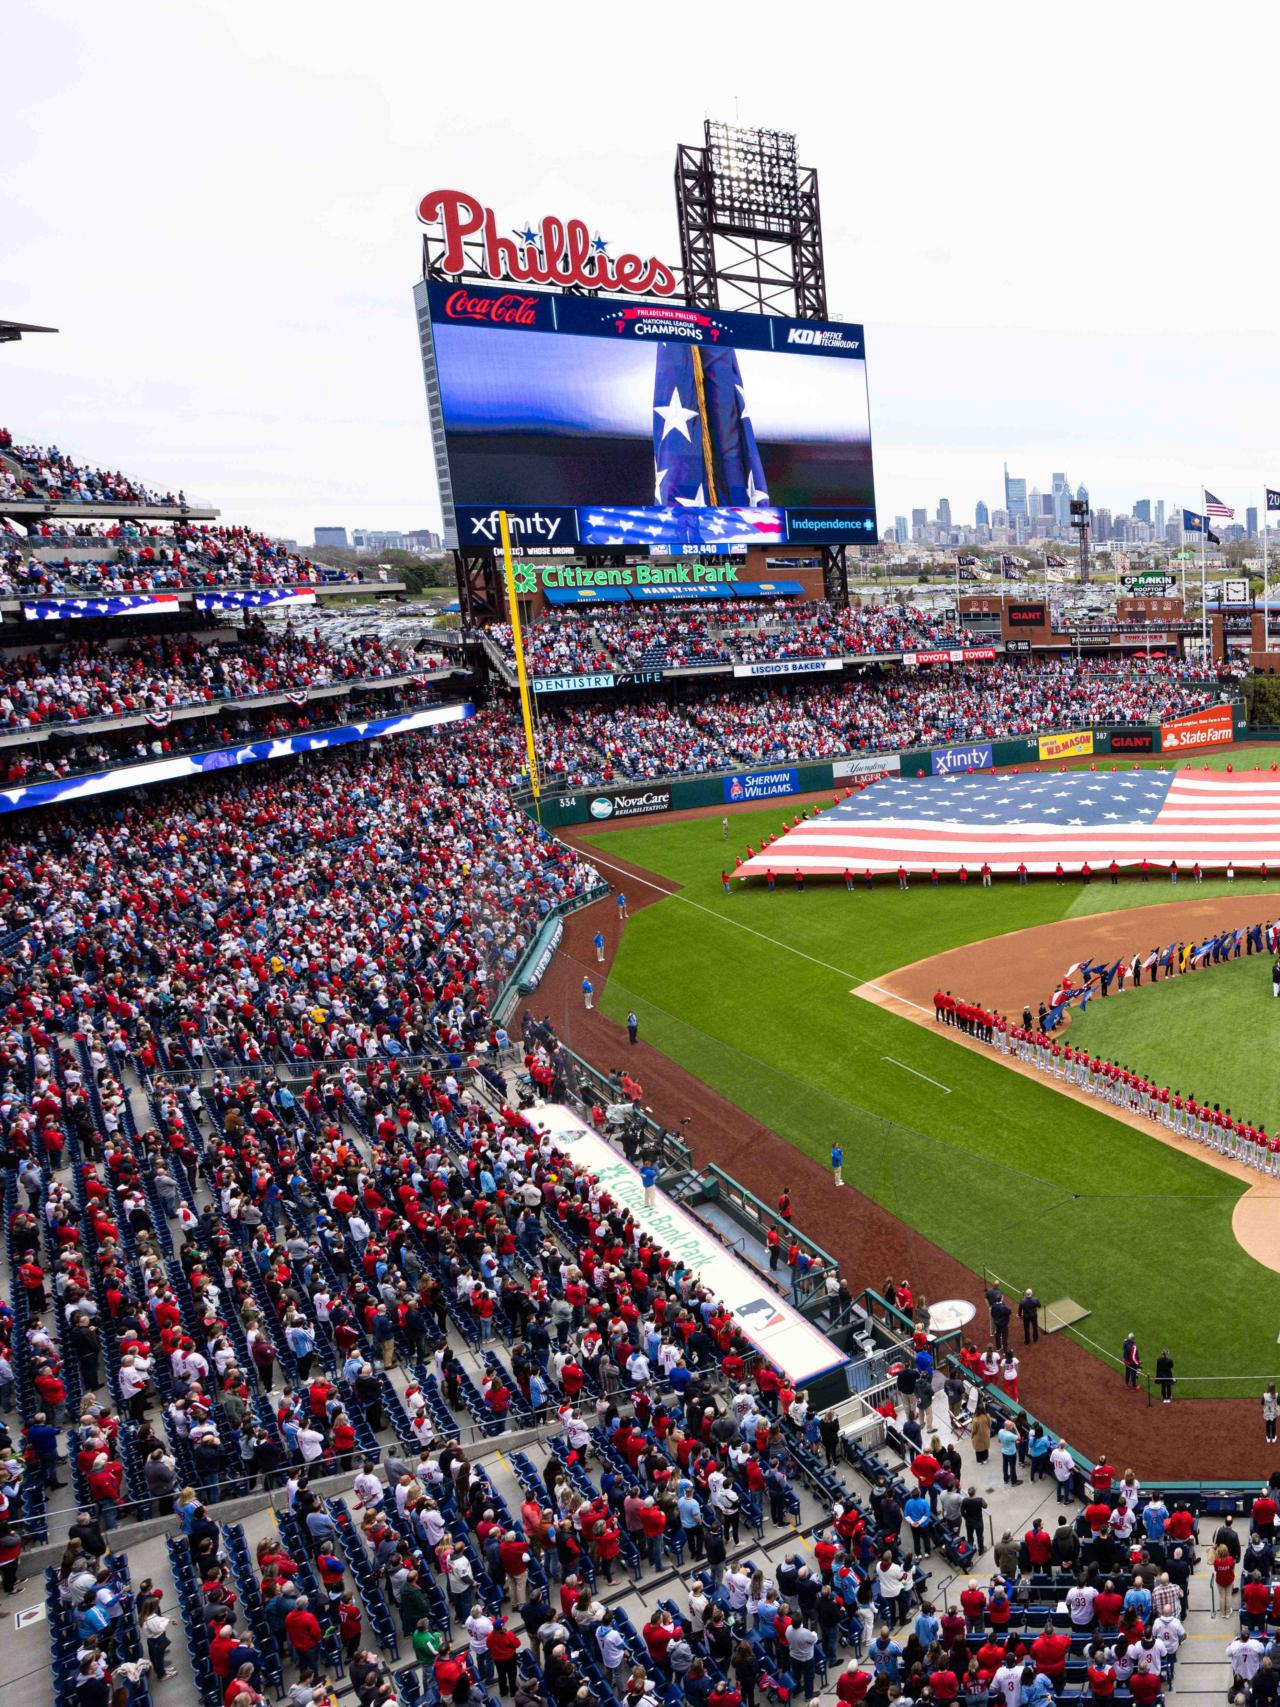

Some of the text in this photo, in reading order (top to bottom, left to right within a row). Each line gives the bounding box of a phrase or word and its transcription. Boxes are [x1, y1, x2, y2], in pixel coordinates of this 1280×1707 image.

[418, 190, 677, 296] Phillies
[445, 289, 540, 325] Coca-Cola
[637, 309, 698, 321] PHILADELPHIA PHILLIES
[642, 318, 695, 329] NATIONAL LEAGUE
[634, 323, 703, 340] CHAMPIONS
[822, 331, 843, 340] OFFICE
[821, 338, 860, 349] TECHNOLOGY
[470, 510, 561, 540] xfnity
[792, 519, 862, 532] Independence
[526, 547, 575, 555] WHOSE BROAD
[541, 562, 738, 587] Citizens Bank Park
[1124, 576, 1138, 584] CP
[642, 586, 682, 594] HARRY
[1012, 612, 1042, 620] GIANT
[918, 652, 949, 662] TOYOTA
[964, 650, 994, 659] TOYOTA
[751, 661, 828, 674] LISCIO'S BAKERY
[534, 671, 661, 691] DENTISTRY for LIFE
[1112, 737, 1152, 747] GIANT
[1180, 728, 1232, 745] State Farm
[936, 749, 989, 772] xfinity
[846, 761, 888, 774] Yuengling
[745, 772, 790, 787] SHERWIN
[560, 797, 576, 808] 334
[613, 792, 670, 809] NovaCare
[615, 803, 668, 816] REHABILITATION
[611, 1179, 717, 1269] Citizens Bank Park
[1075, 1597, 1086, 1607] 33
[877, 1655, 890, 1664] 20
[1146, 1654, 1152, 1663] 3
[1242, 1654, 1248, 1663] 7
[1008, 1681, 1014, 1691] 3
